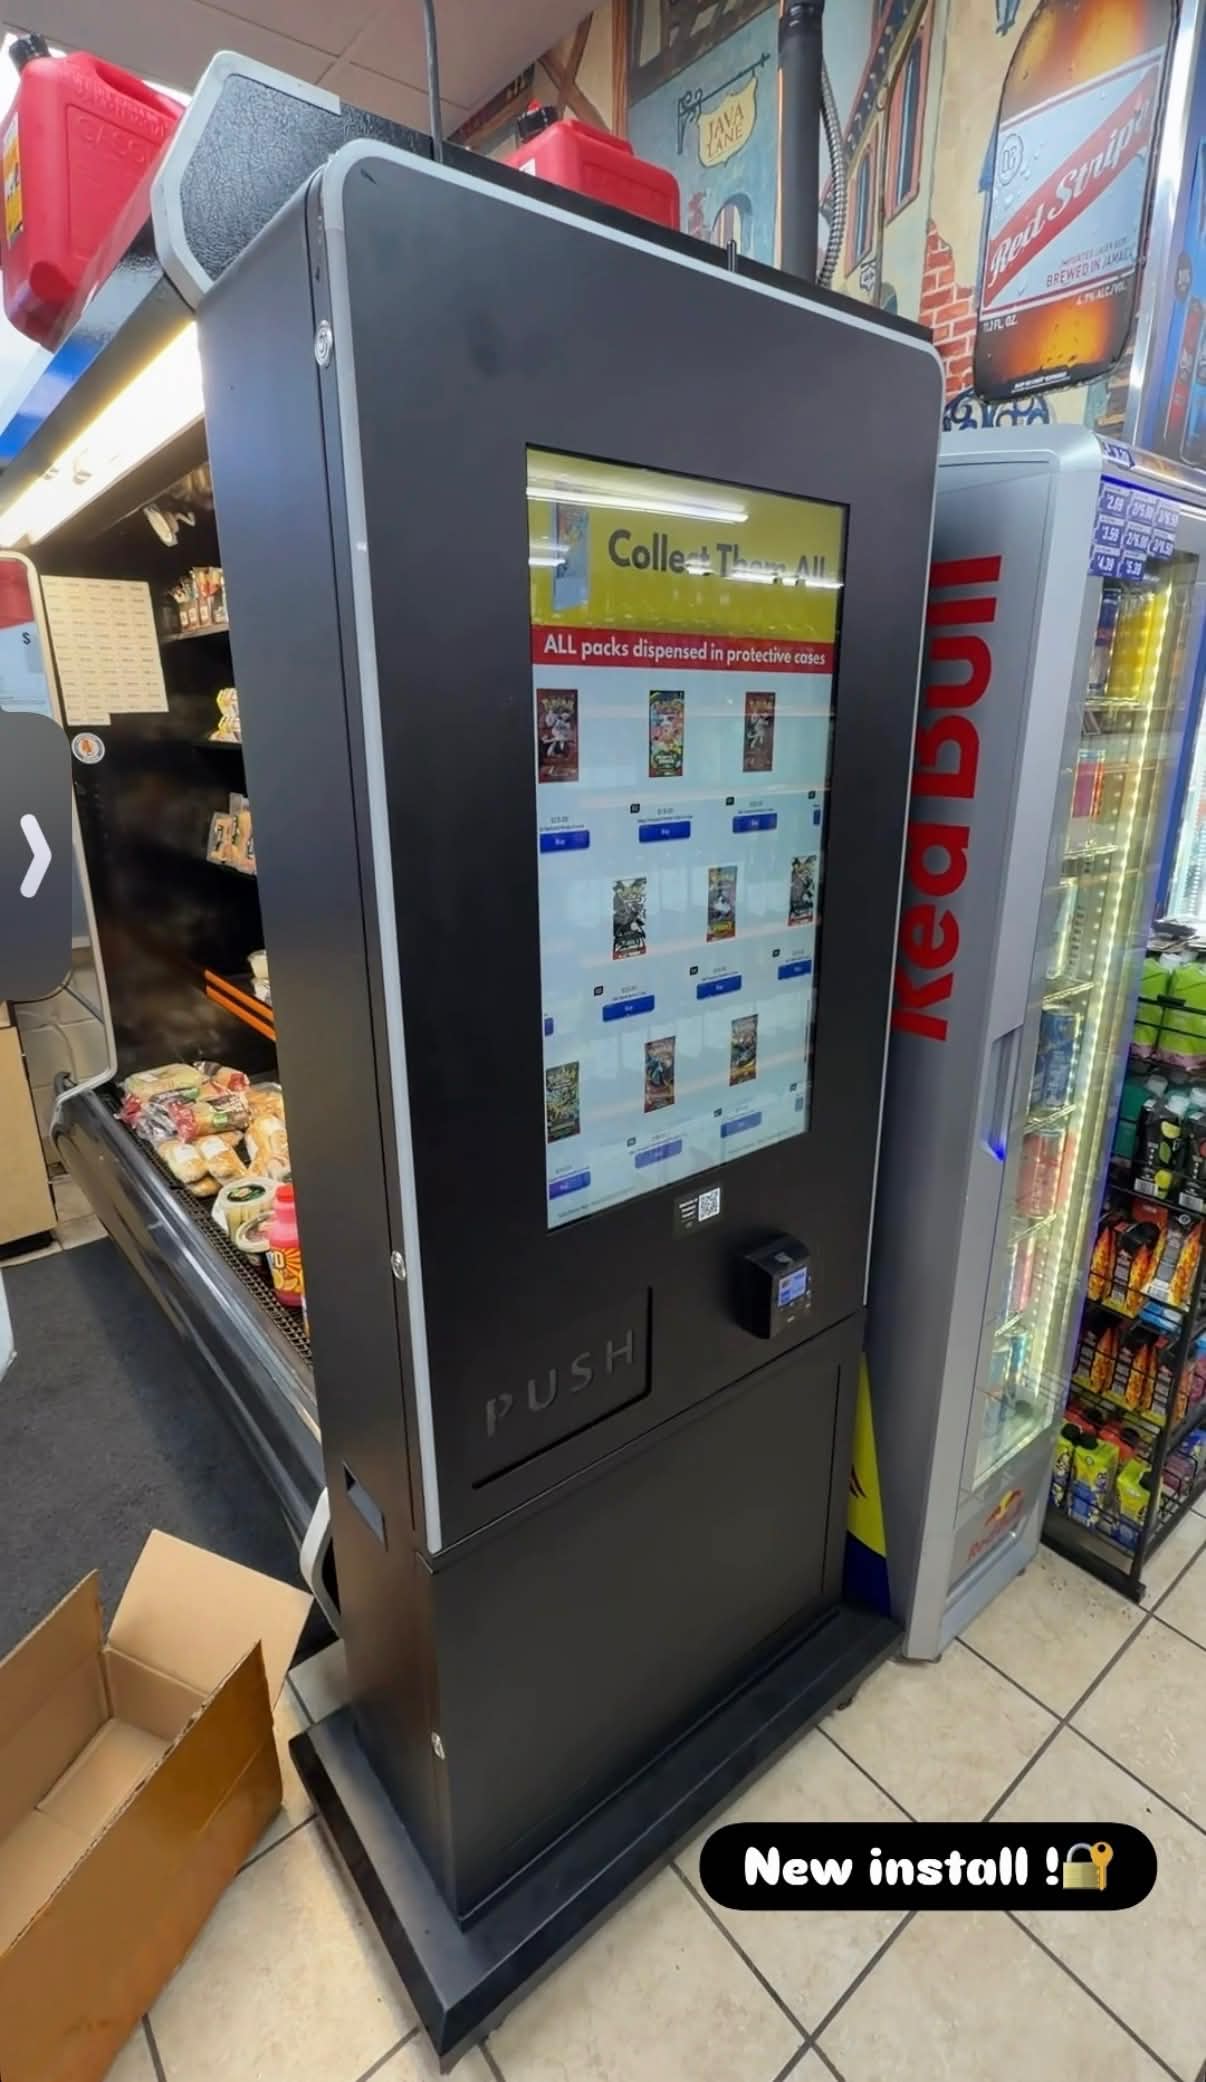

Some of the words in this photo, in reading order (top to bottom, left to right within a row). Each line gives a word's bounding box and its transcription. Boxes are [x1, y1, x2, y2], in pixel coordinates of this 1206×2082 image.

[708, 103, 744, 140] JAVA
[707, 124, 743, 159] LANE
[987, 205, 1046, 288] Red
[1046, 262, 1090, 288] BREWED
[1089, 257, 1101, 273] IN
[544, 634, 577, 655] ALL
[581, 636, 629, 660] packs
[633, 638, 708, 663] dispensed
[711, 643, 724, 661] in
[727, 647, 792, 666] protective
[794, 651, 826, 665] cases
[914, 555, 1002, 799] Bull
[485, 1328, 633, 1438] PUSH
